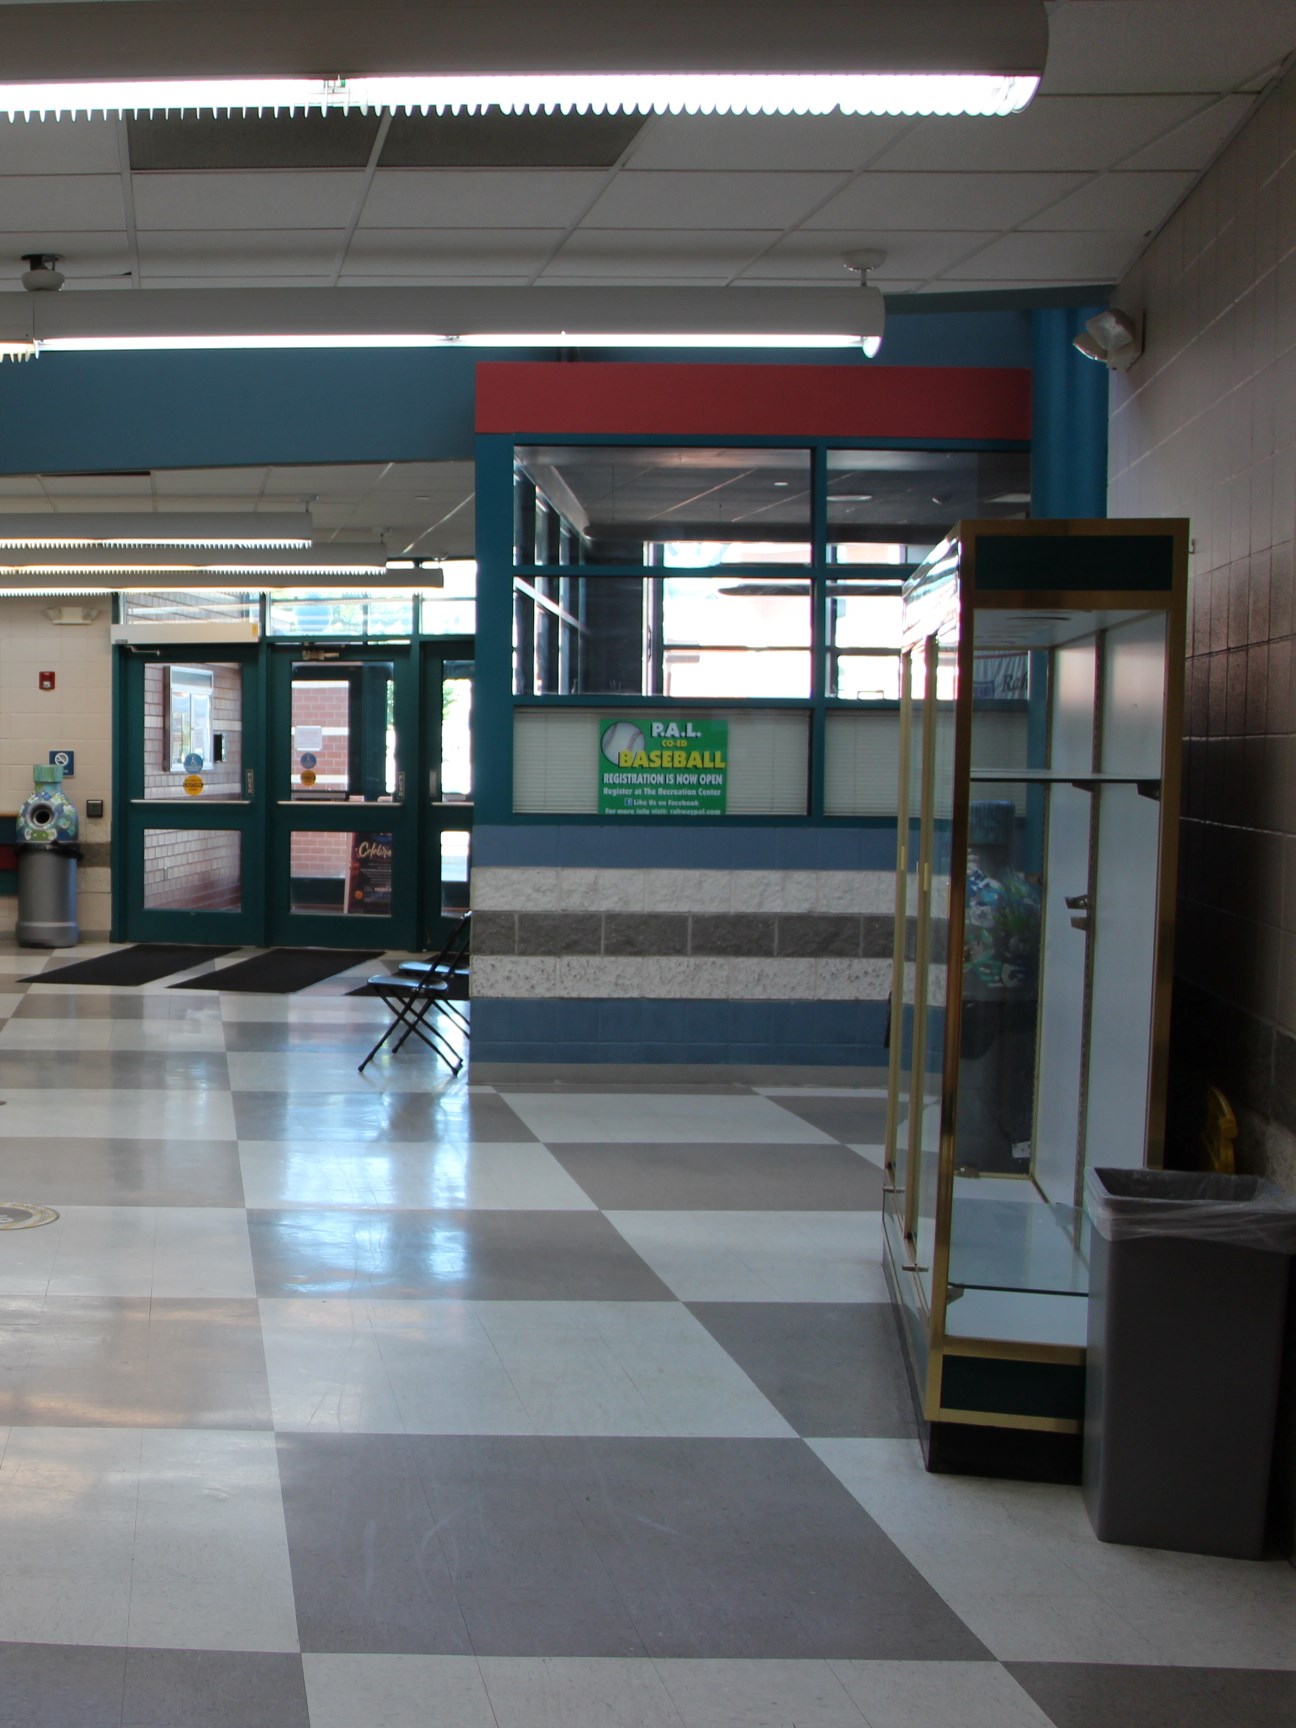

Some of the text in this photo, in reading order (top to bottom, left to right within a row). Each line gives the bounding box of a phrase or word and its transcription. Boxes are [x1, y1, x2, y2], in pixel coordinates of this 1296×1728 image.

[651, 722, 702, 738] P.A.L.
[661, 740, 688, 748] CO-ED
[619, 750, 725, 768] BASEBALL
[604, 773, 723, 785] REGISTRATION IS NOW OPEN
[603, 787, 633, 796] Register
[658, 788, 696, 796] Recreation
[698, 788, 721, 796] Center
